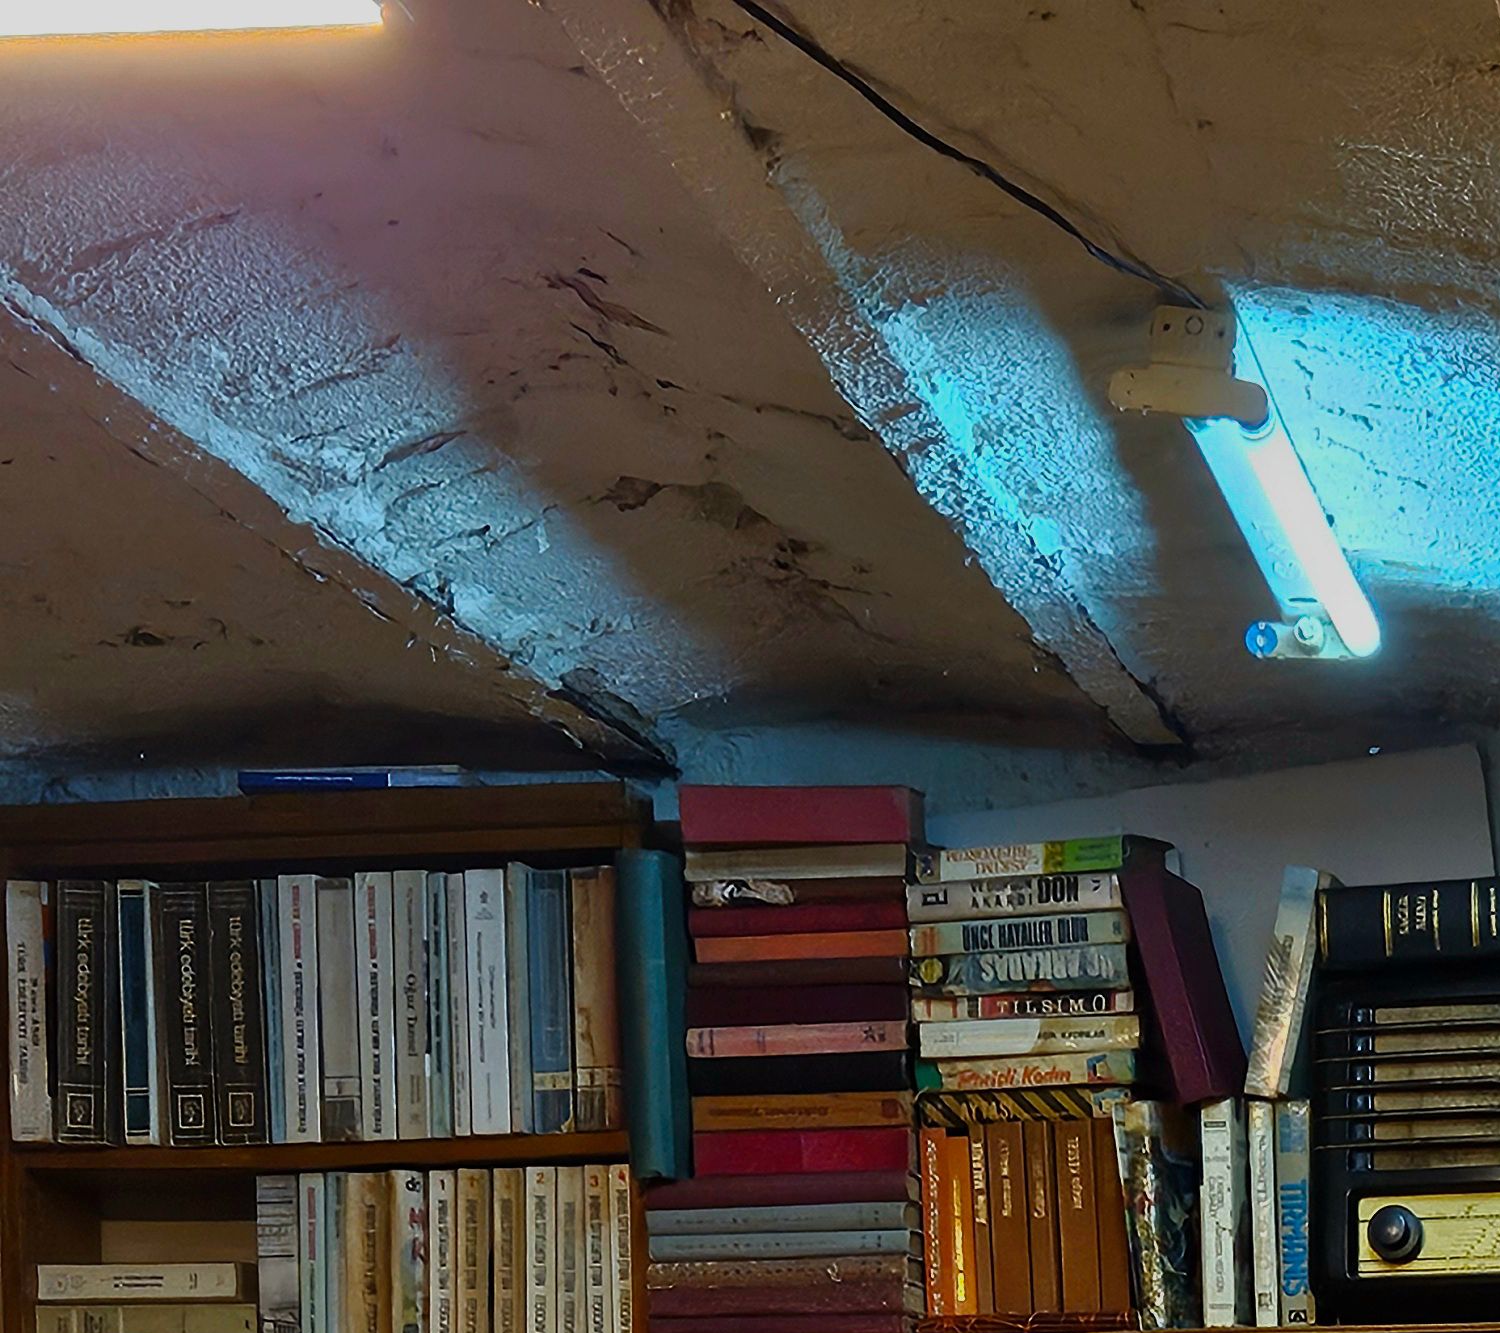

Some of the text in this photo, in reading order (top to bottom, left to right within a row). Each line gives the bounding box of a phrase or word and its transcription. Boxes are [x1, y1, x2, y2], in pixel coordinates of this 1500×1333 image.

[1037, 876, 1079, 904] DON
[77, 918, 90, 949] türk
[178, 919, 195, 951] türk
[228, 916, 242, 947] türk
